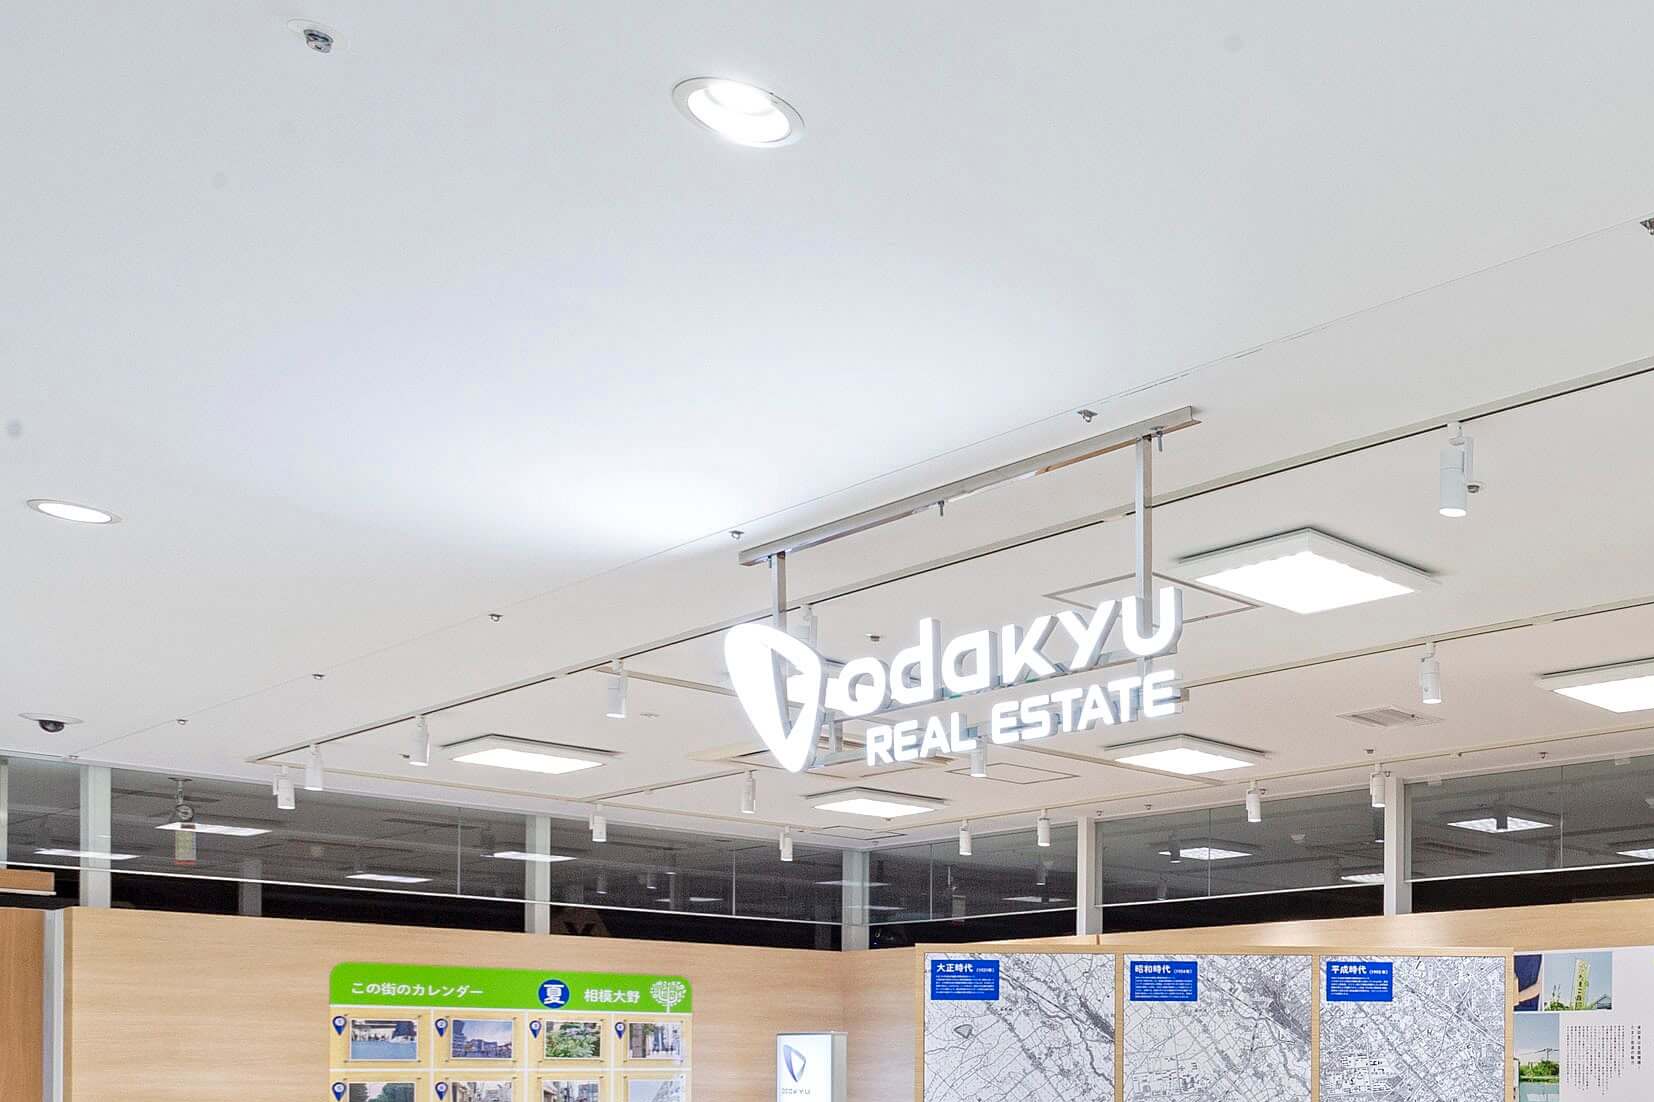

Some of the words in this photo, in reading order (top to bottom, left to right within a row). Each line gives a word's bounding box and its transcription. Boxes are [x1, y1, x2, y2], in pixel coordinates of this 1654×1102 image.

[866, 711, 977, 767] REAL
[990, 669, 1184, 746] ESTATE
[936, 962, 974, 973] 大正時代
[1134, 964, 1172, 974] 昭和時代
[1331, 965, 1368, 974] 平成時代
[351, 981, 484, 999] この街のカレンダー
[543, 984, 565, 1005] 夏
[583, 988, 641, 1004] 相模大野
